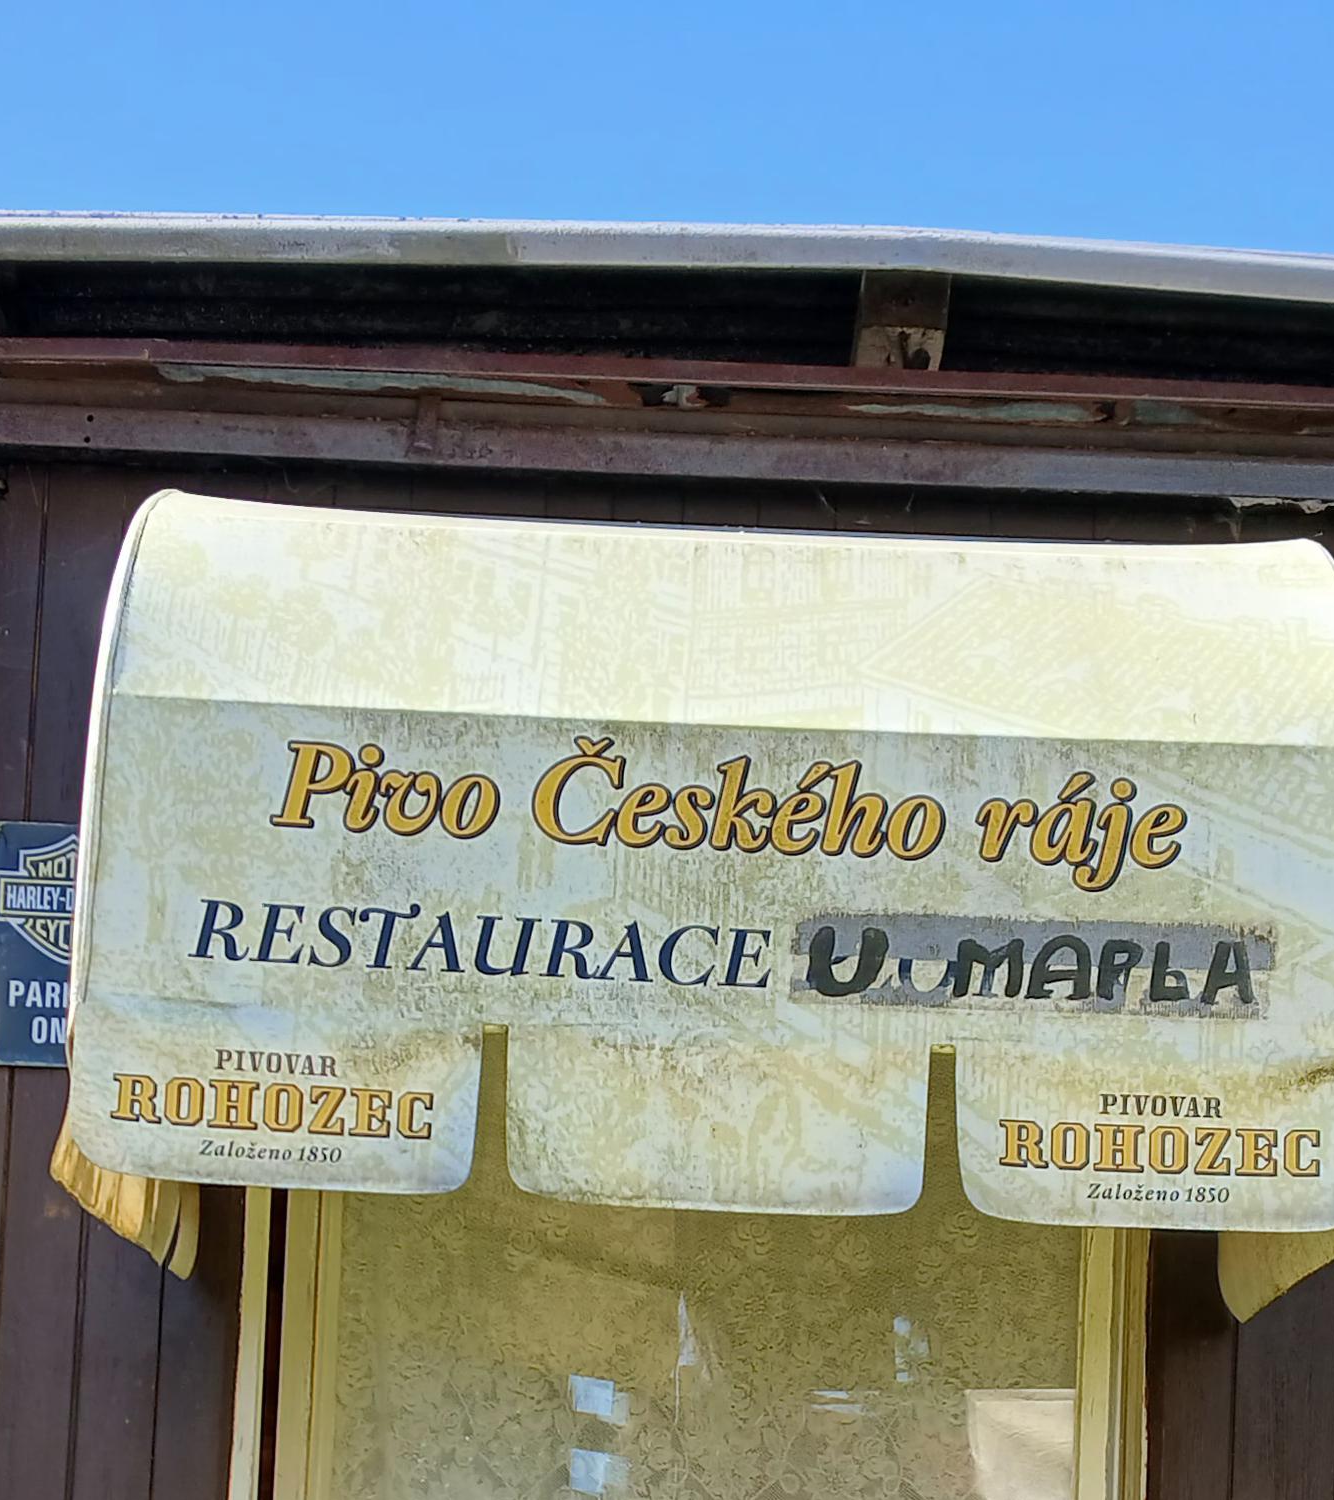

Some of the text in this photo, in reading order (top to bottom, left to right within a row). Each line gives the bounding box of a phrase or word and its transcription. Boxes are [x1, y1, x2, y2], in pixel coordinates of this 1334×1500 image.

[270, 735, 1188, 892] Pivo Českého ráje
[38, 851, 76, 878] MOT
[7, 885, 75, 911] HARLEY-D
[187, 899, 772, 989] RESTAURACE
[9, 980, 70, 1008] PAR
[31, 1016, 67, 1044] ON
[215, 1049, 338, 1078] PIVOVAR
[110, 1073, 434, 1140] ROHOZEC
[1098, 1093, 1223, 1118] PIVOVAR
[198, 1139, 342, 1164] Založeno 1850
[998, 1119, 1321, 1177] ROHOZEC
[1087, 1182, 1230, 1203] Založeno 1850
